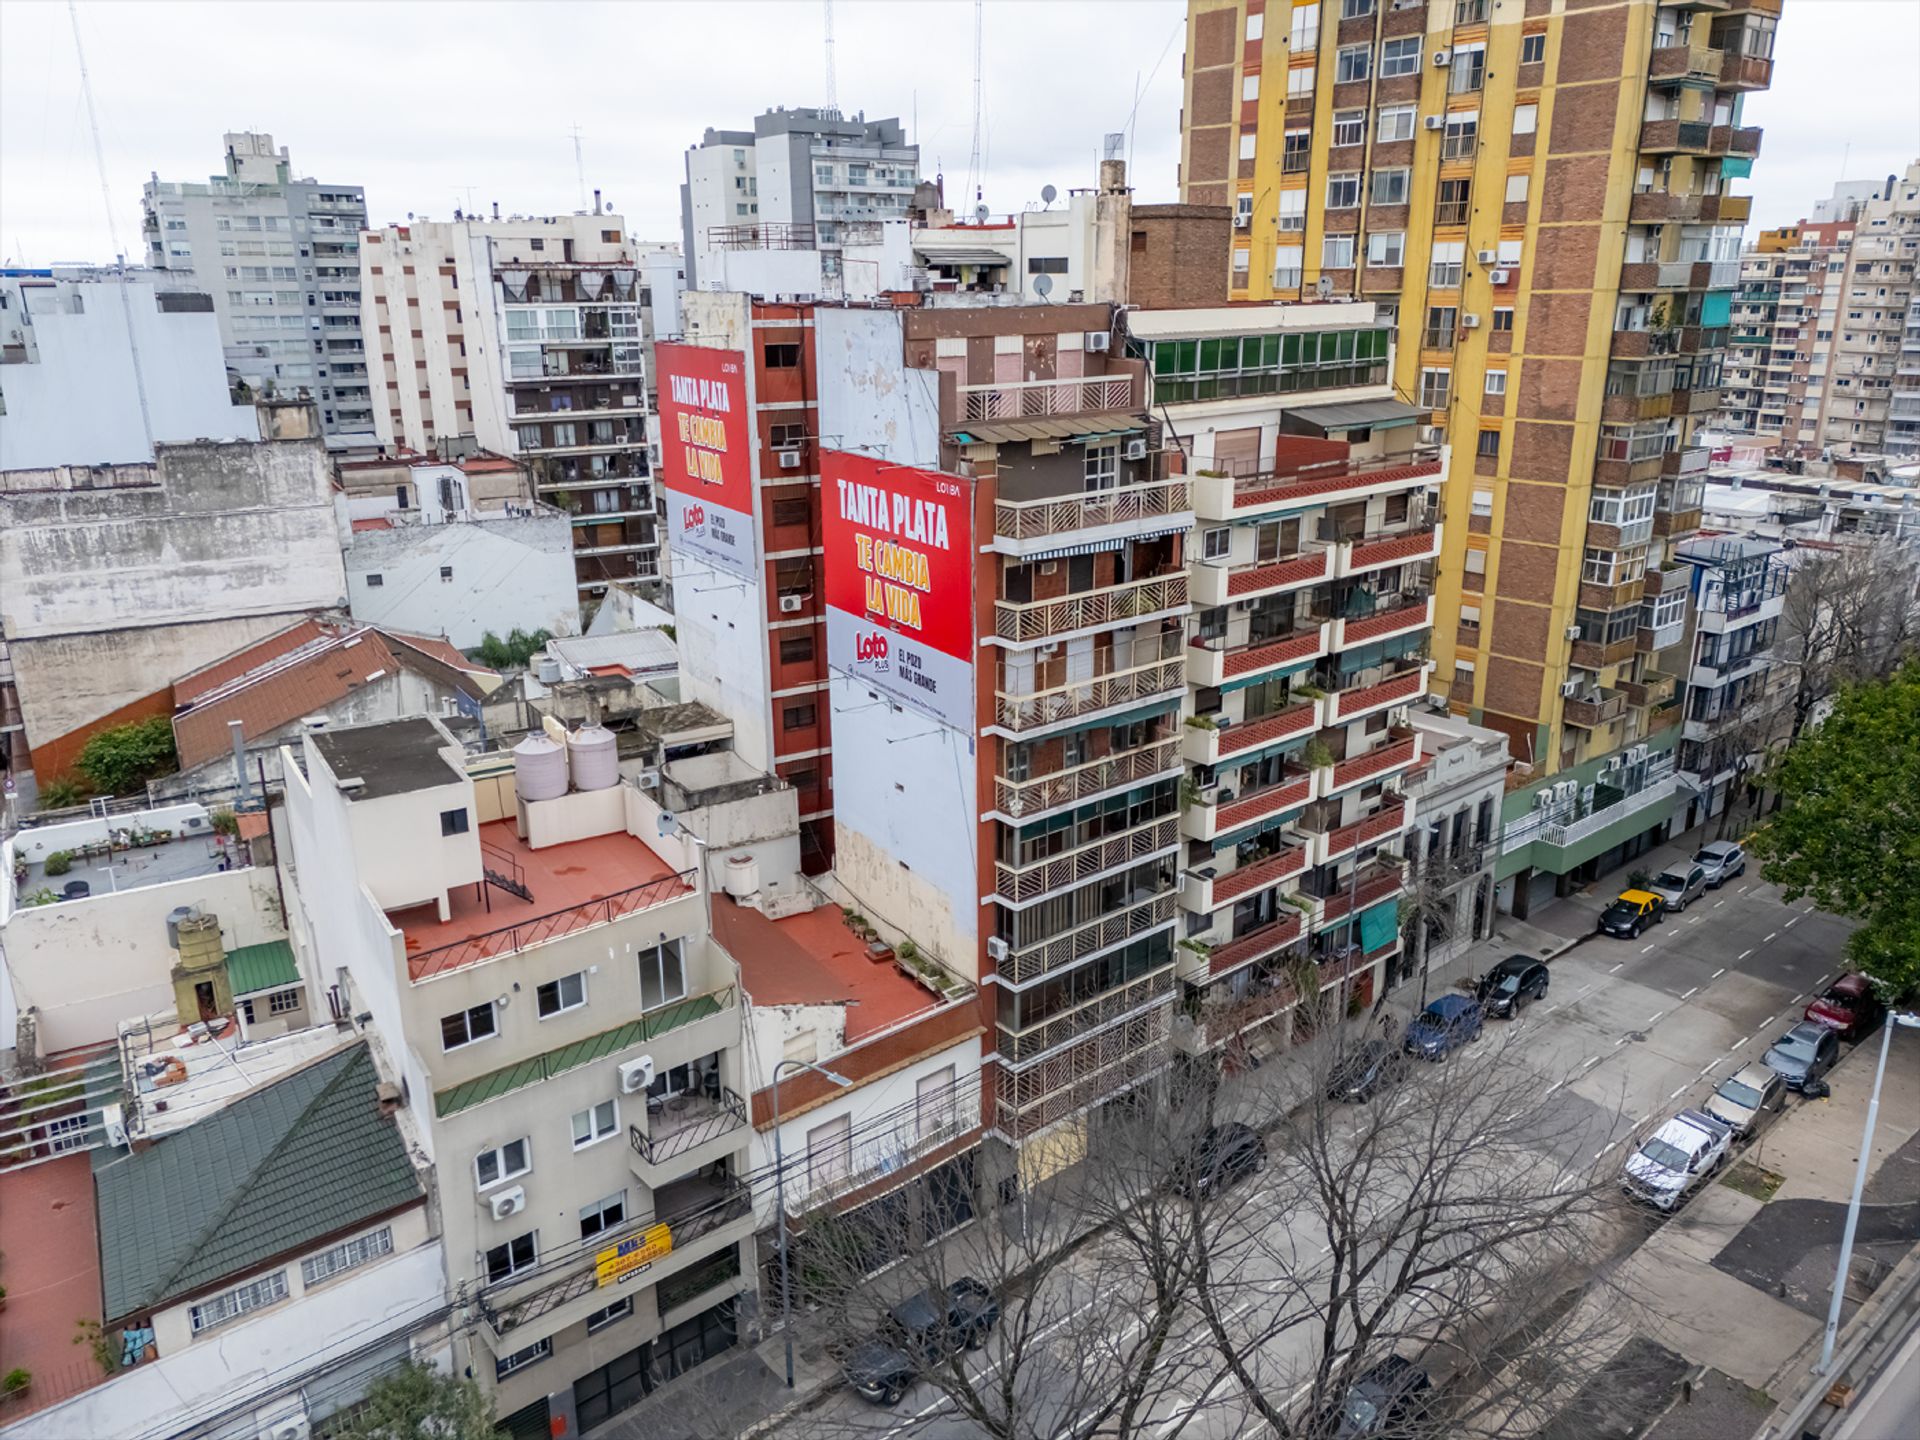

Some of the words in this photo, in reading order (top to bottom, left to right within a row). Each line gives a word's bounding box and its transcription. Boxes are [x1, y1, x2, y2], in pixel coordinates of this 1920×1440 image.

[670, 375, 699, 406] TANTA
[700, 381, 730, 412] PLATA
[677, 412, 691, 443] TE
[689, 414, 727, 453] CAMBIA
[685, 446, 699, 478] LA
[697, 449, 724, 485] VIDA
[683, 503, 705, 530] Loto
[837, 479, 889, 532] TANTA
[893, 492, 949, 550] PLATA
[855, 533, 873, 571] TE
[874, 539, 931, 592] CAMBIA
[865, 576, 884, 615] LA
[885, 581, 922, 631] VIDA
[855, 630, 889, 662] Loto
[898, 649, 906, 663] EL
[906, 652, 922, 670] POZO
[874, 659, 889, 672] PLUS
[914, 671, 937, 694] GRANDE
